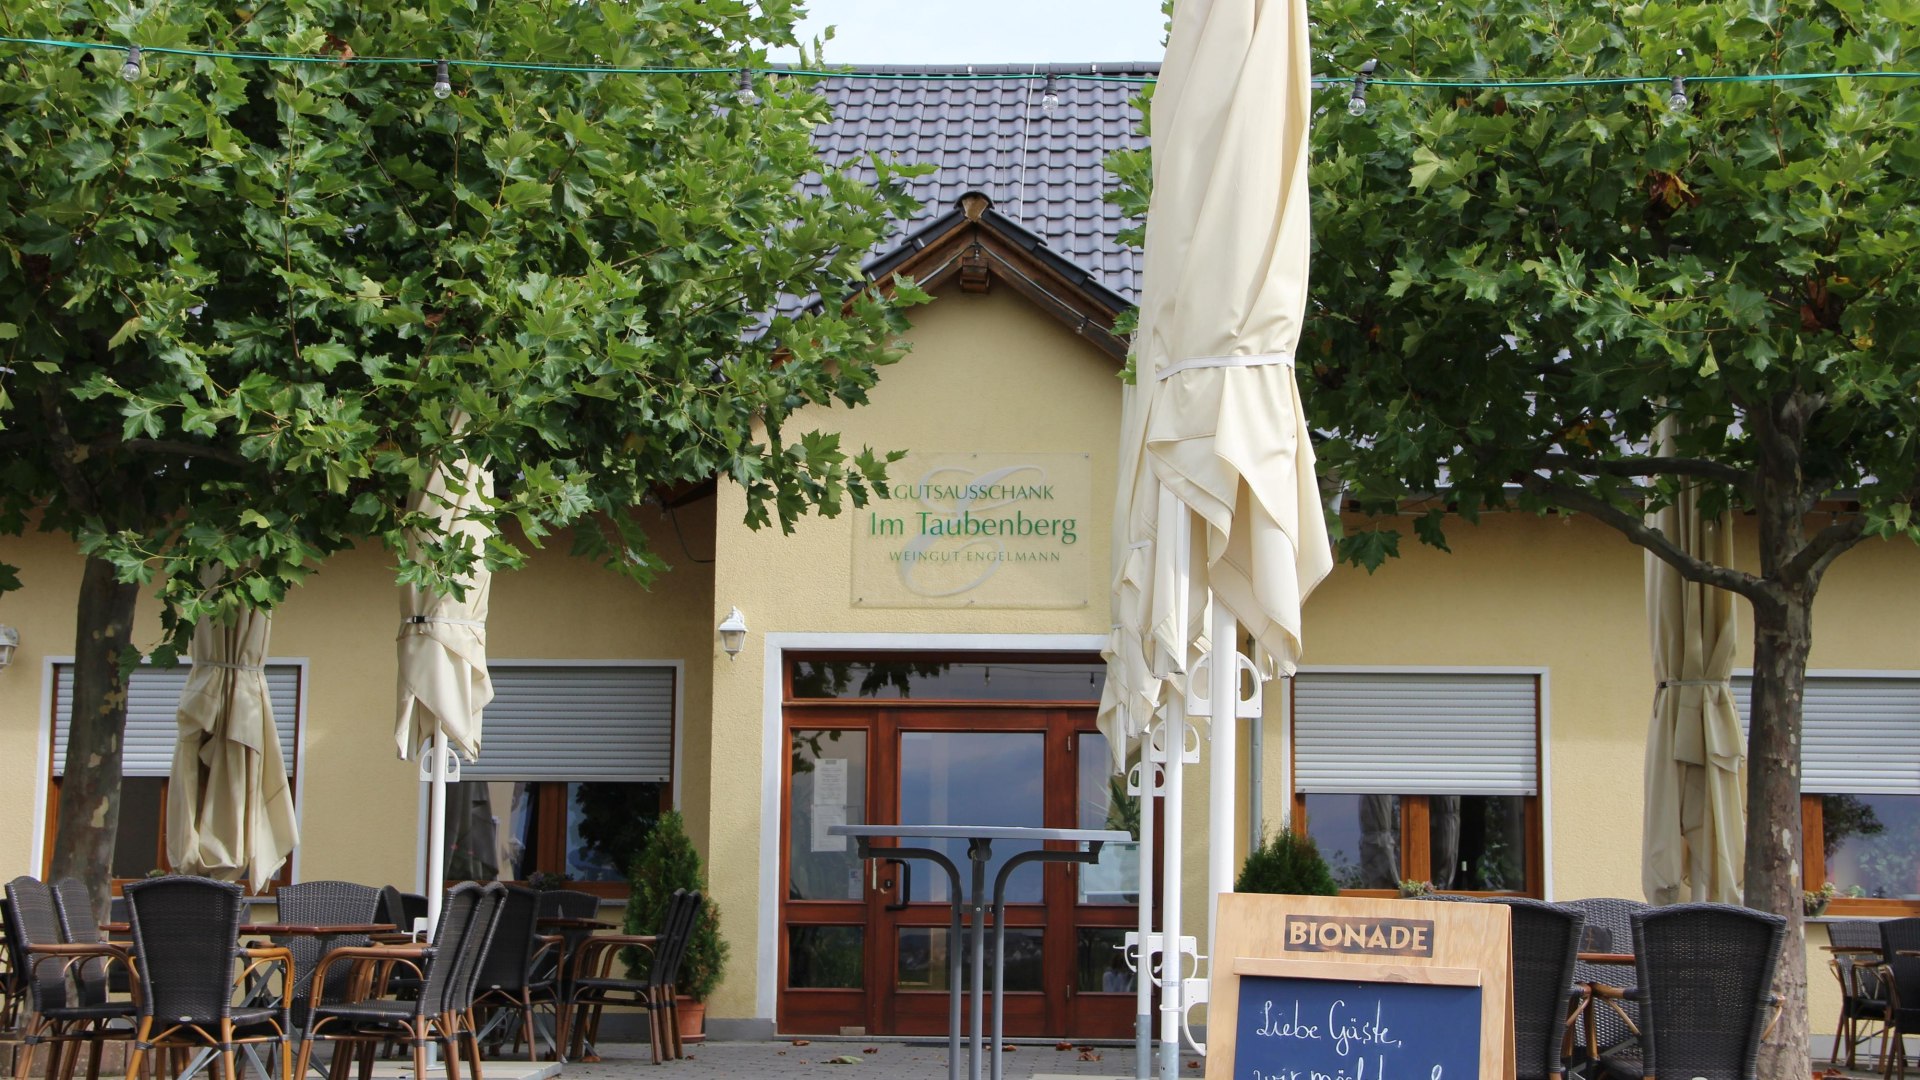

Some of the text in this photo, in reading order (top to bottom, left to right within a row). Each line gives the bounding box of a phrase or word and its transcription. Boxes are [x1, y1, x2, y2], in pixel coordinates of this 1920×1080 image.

[894, 484, 1054, 500] GUTSAUSSCHANK
[871, 510, 1077, 545] Im Taubenberg
[889, 551, 1061, 562] WEINGUT ENGELMANN
[1289, 921, 1428, 951] BIONADE
[1256, 999, 1402, 1056] Liebe Gäste,
